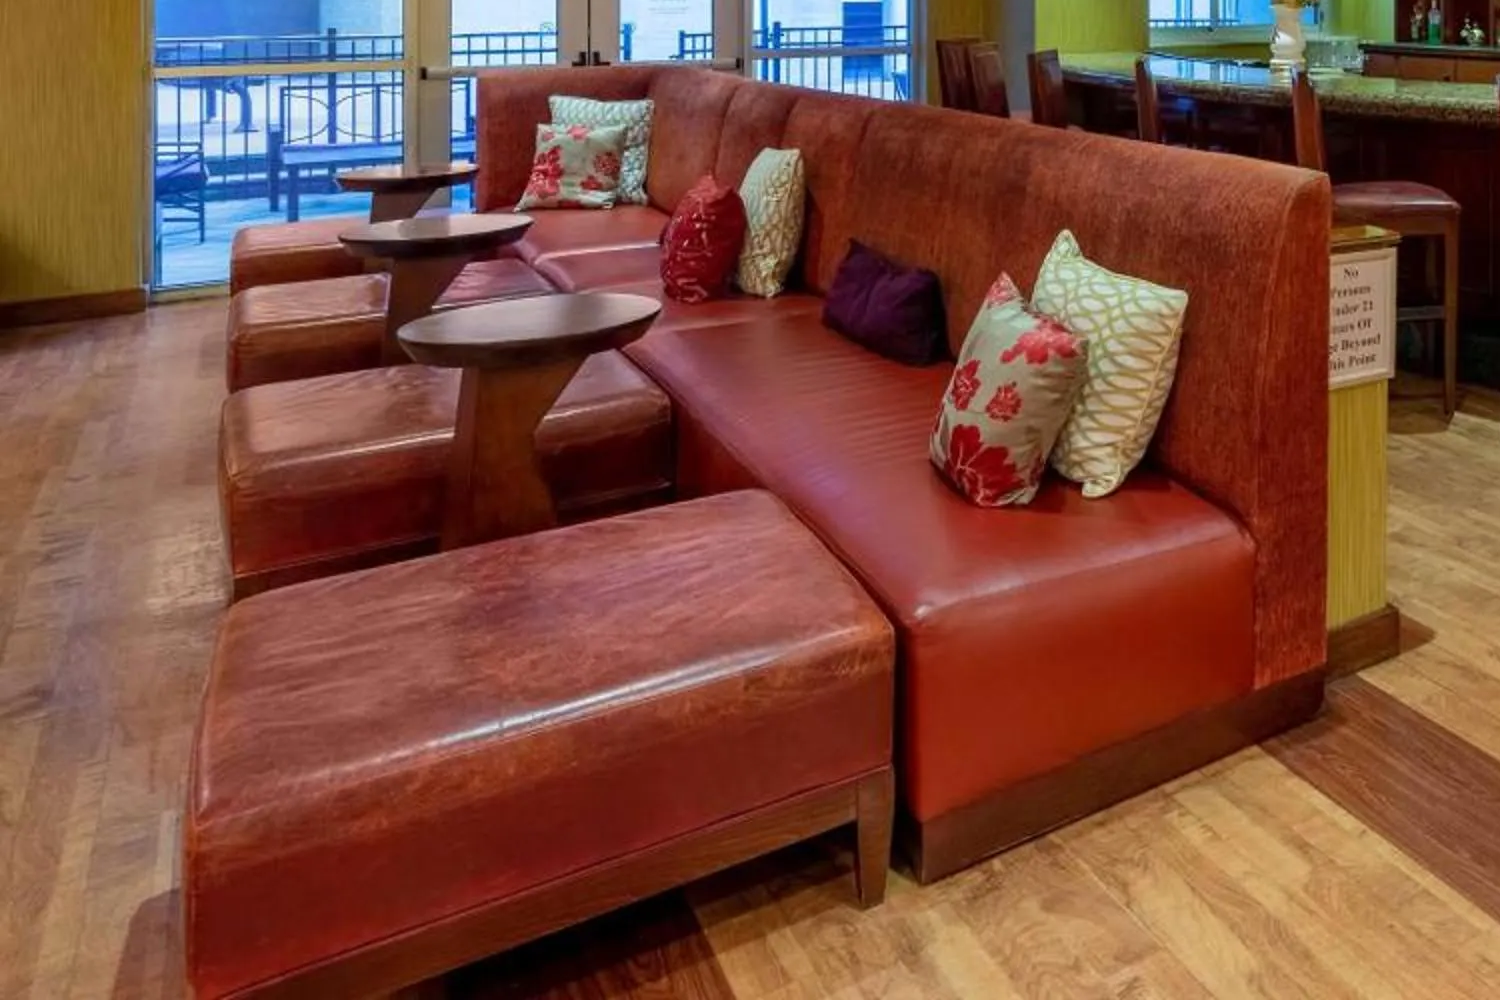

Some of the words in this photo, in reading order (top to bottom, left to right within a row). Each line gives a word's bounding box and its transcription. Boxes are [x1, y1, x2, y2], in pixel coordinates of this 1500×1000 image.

[1343, 267, 1359, 279] No
[1331, 303, 1361, 317] nder
[1362, 300, 1373, 312] 21
[1331, 323, 1354, 335] ears
[1341, 332, 1381, 351] Beyond
[1349, 353, 1377, 368] Point
